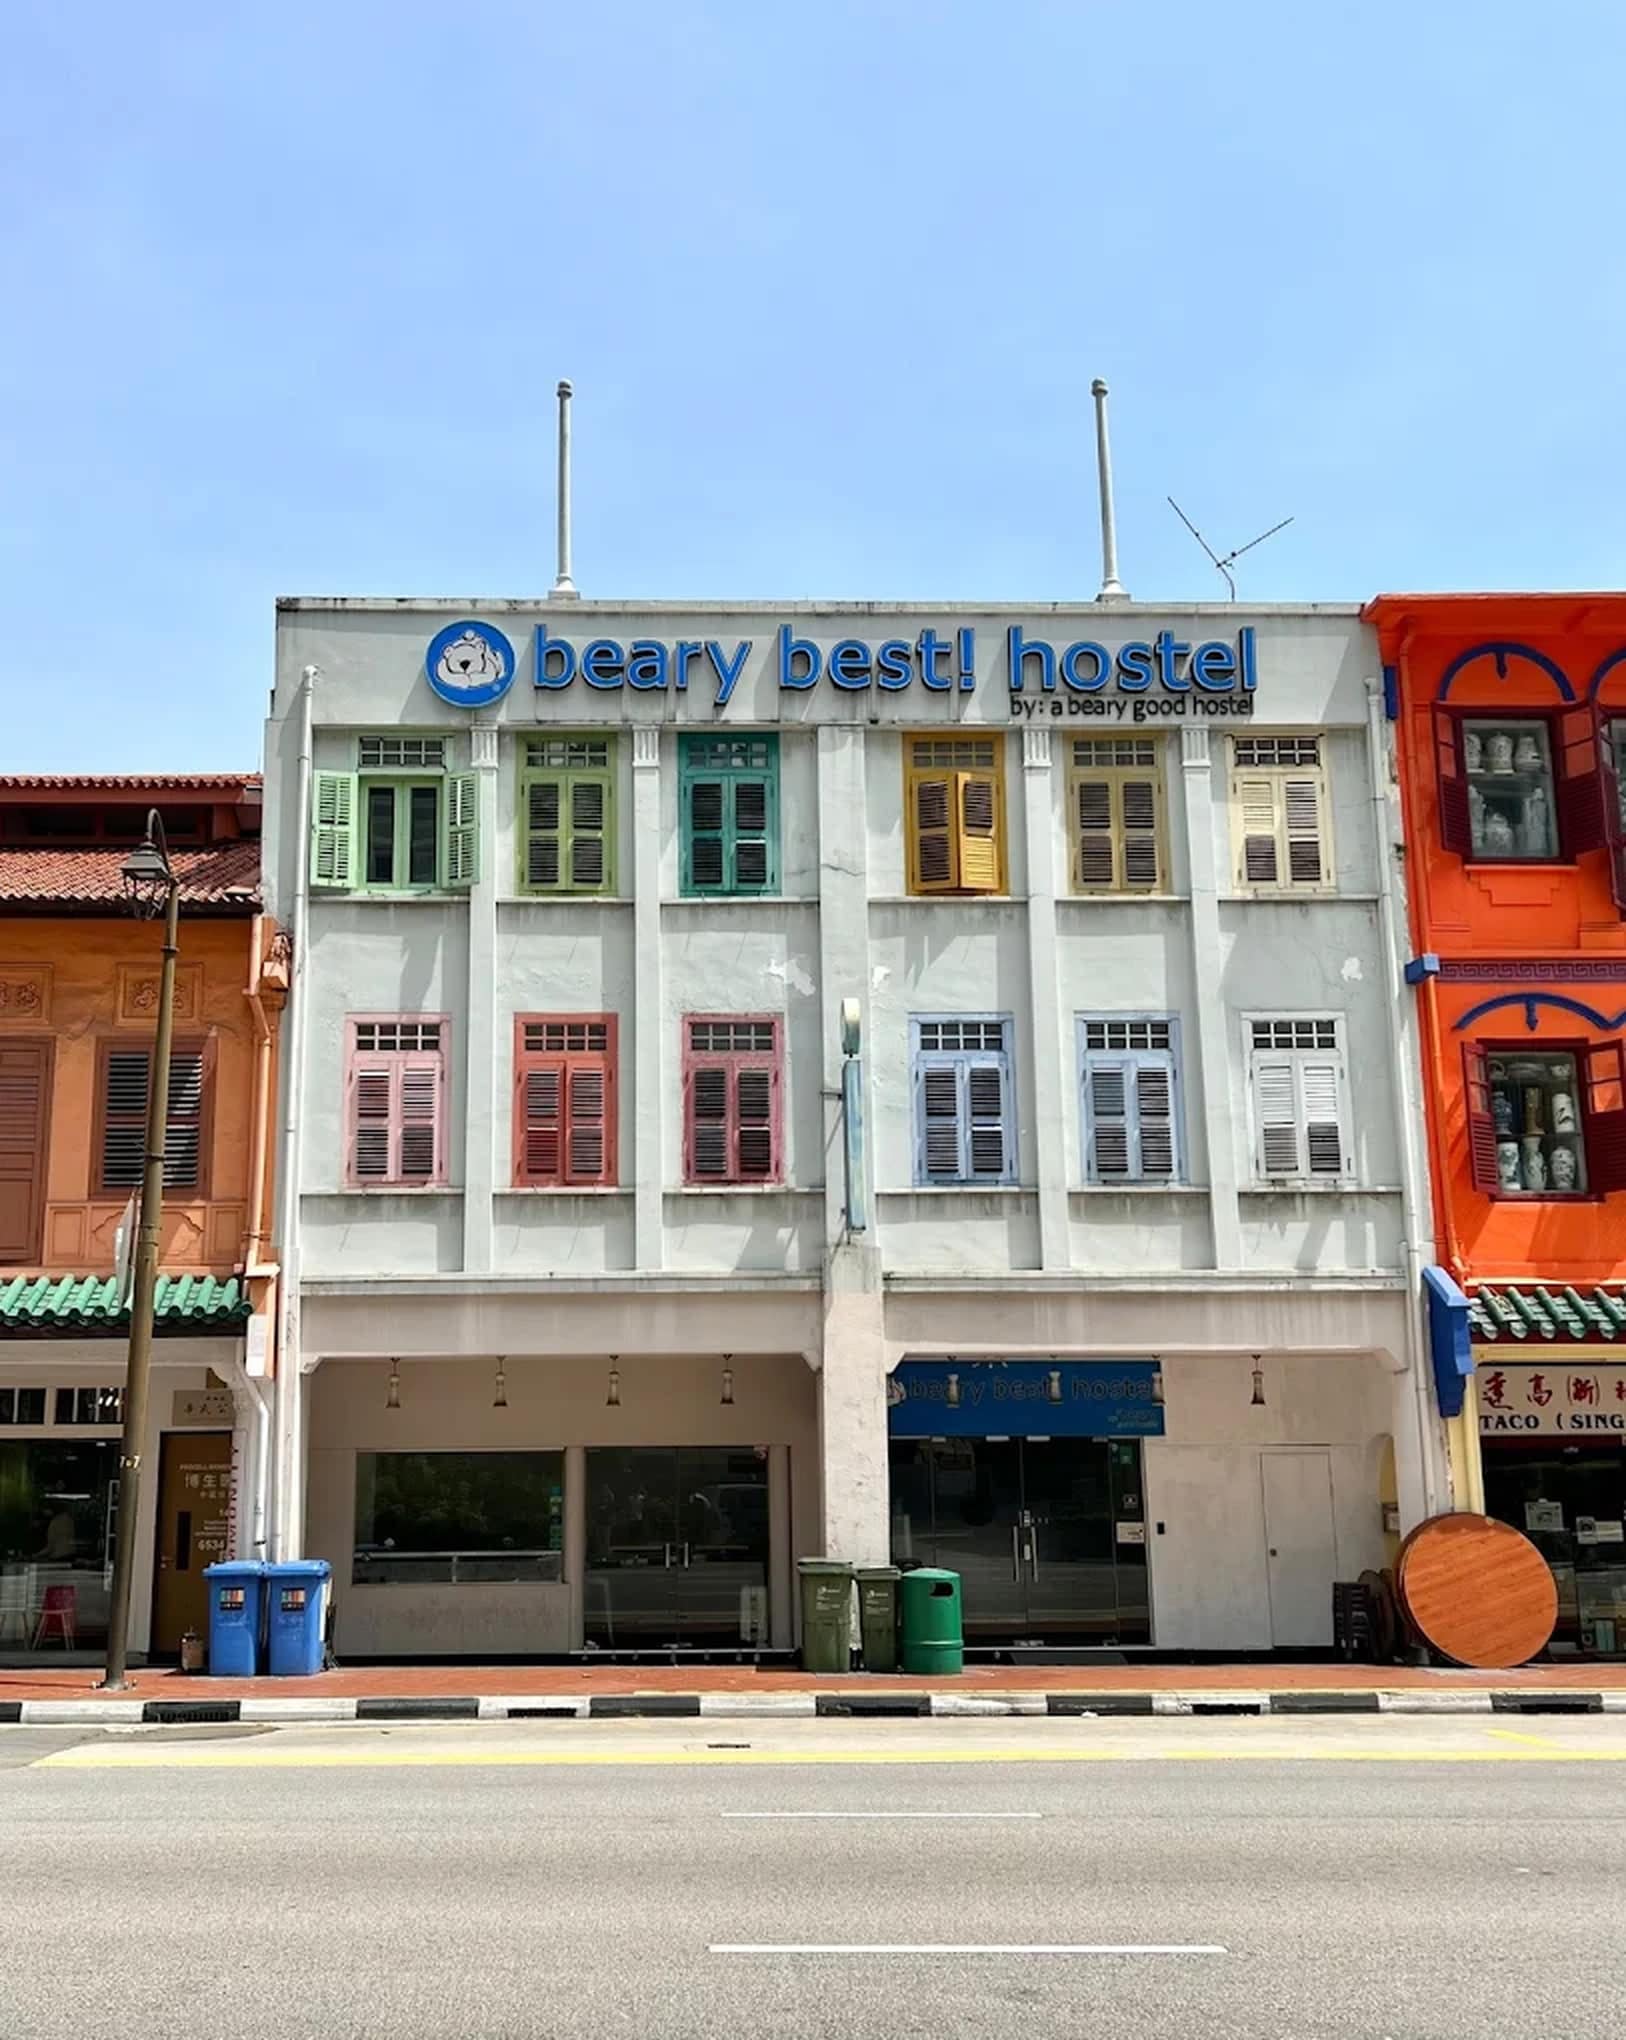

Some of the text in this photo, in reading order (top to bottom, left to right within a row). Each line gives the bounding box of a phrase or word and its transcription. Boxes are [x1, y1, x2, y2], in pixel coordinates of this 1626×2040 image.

[534, 623, 1256, 706] beary best! hostel
[1010, 692, 1254, 722] by: a beary good hostel
[909, 1375, 986, 1406] bery
[1072, 1376, 1153, 1401] hoste
[1478, 1414, 1539, 1430] TACO
